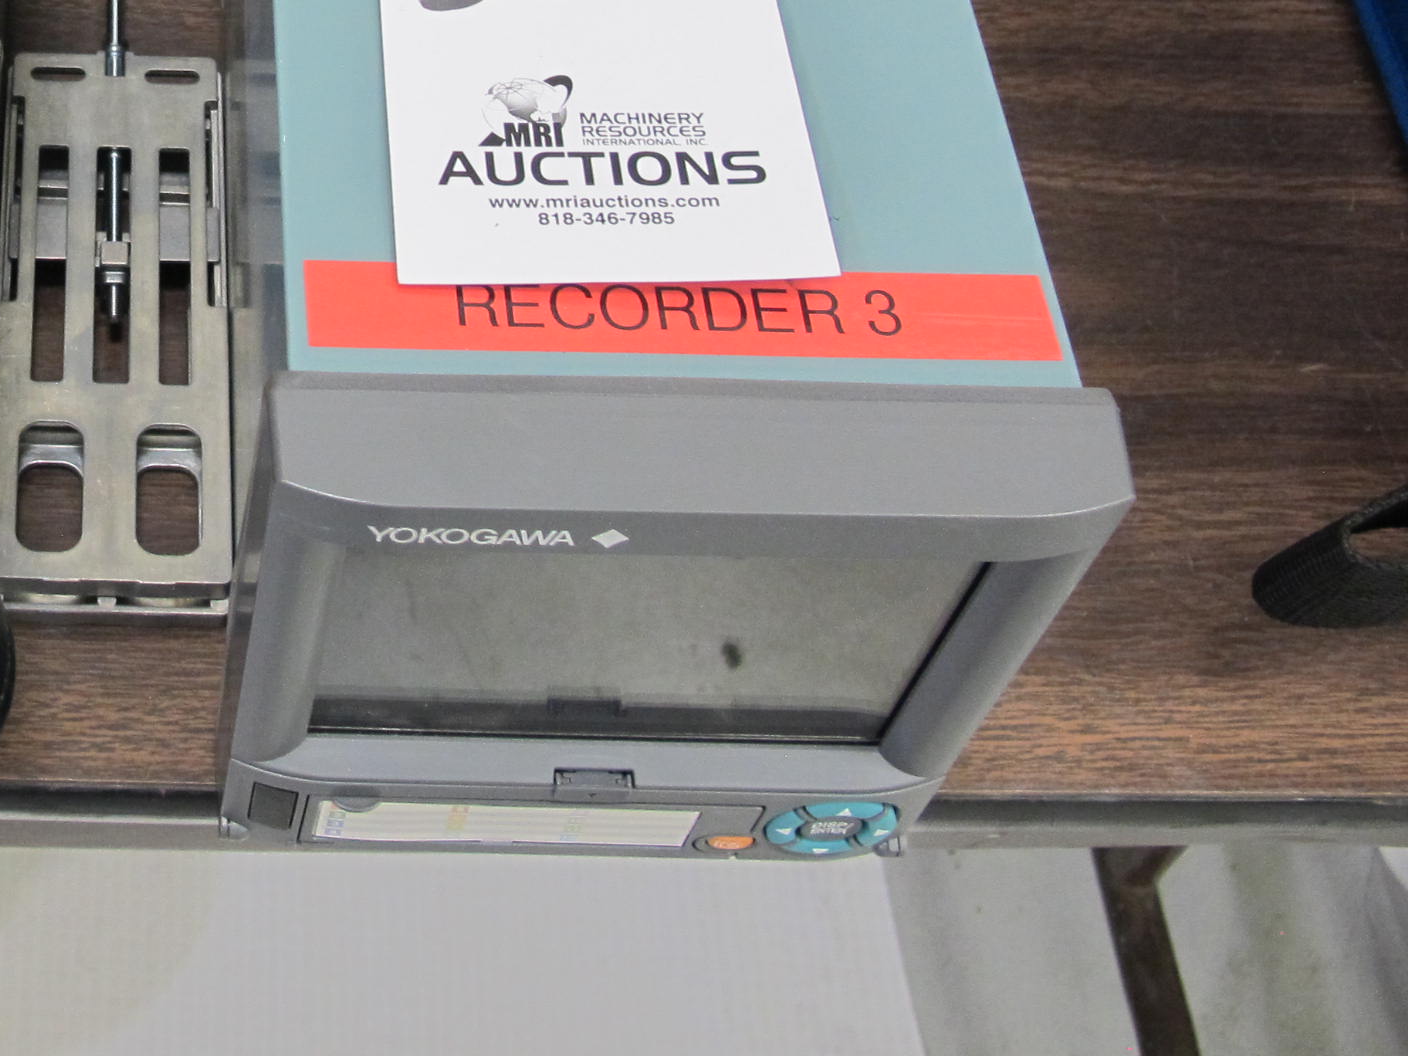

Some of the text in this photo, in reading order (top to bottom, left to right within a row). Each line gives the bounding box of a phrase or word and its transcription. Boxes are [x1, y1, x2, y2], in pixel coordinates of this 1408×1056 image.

[579, 112, 705, 125] MACHINERY
[502, 122, 565, 147] MRI
[581, 125, 707, 138] RESOURCES
[438, 150, 767, 186] AUCTIONS
[488, 194, 721, 210] www.mriauctions.com
[538, 211, 676, 226] 818-346-7985
[456, 283, 904, 337] RECORDER 3
[367, 524, 575, 547] YOKOGAWA
